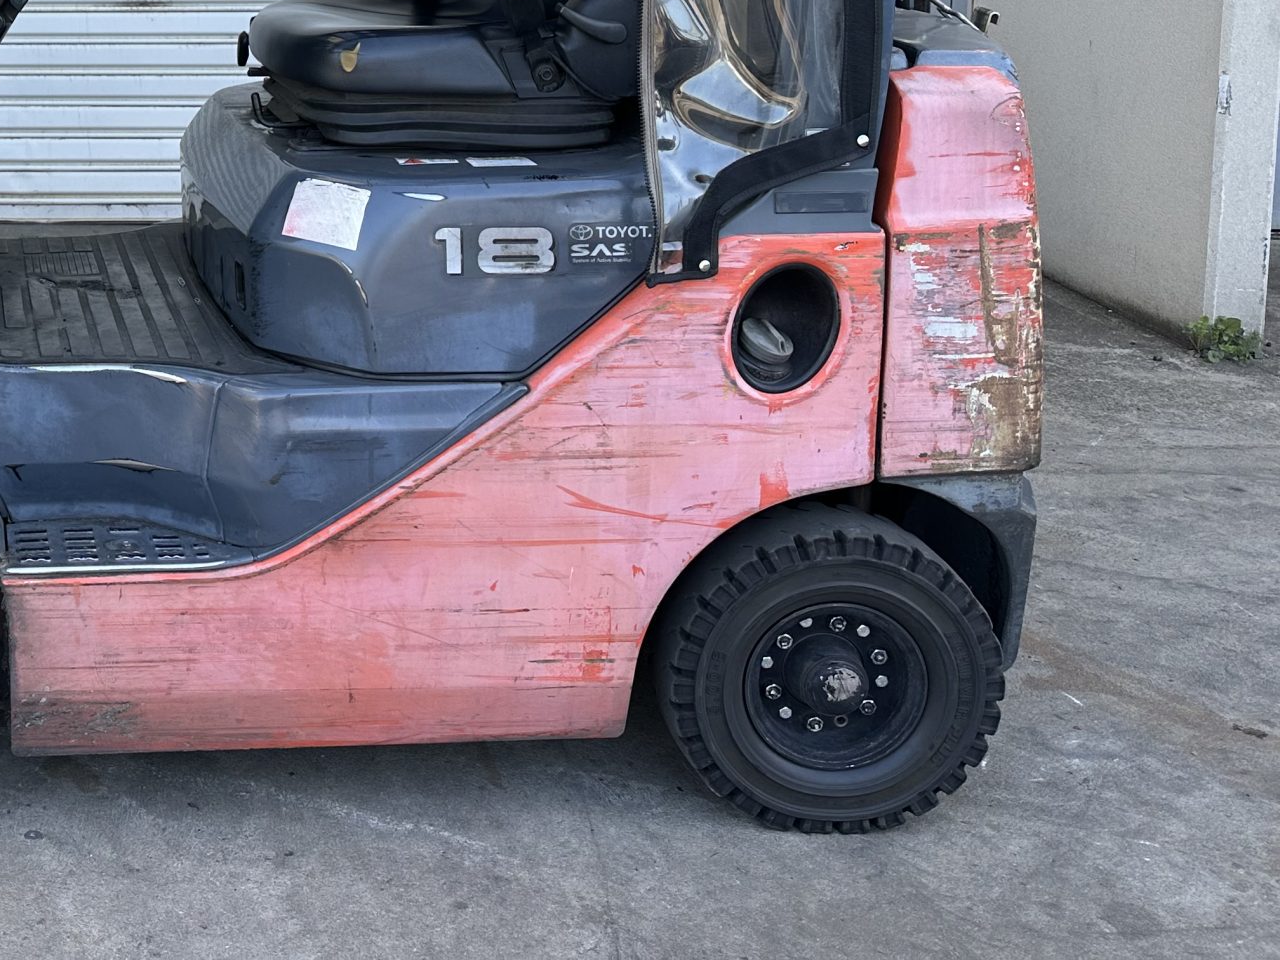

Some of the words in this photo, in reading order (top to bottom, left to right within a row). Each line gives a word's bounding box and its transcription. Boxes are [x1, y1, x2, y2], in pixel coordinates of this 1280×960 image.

[595, 225, 653, 239] TOYOT
[434, 226, 557, 275] 18
[570, 243, 630, 257] SAS
